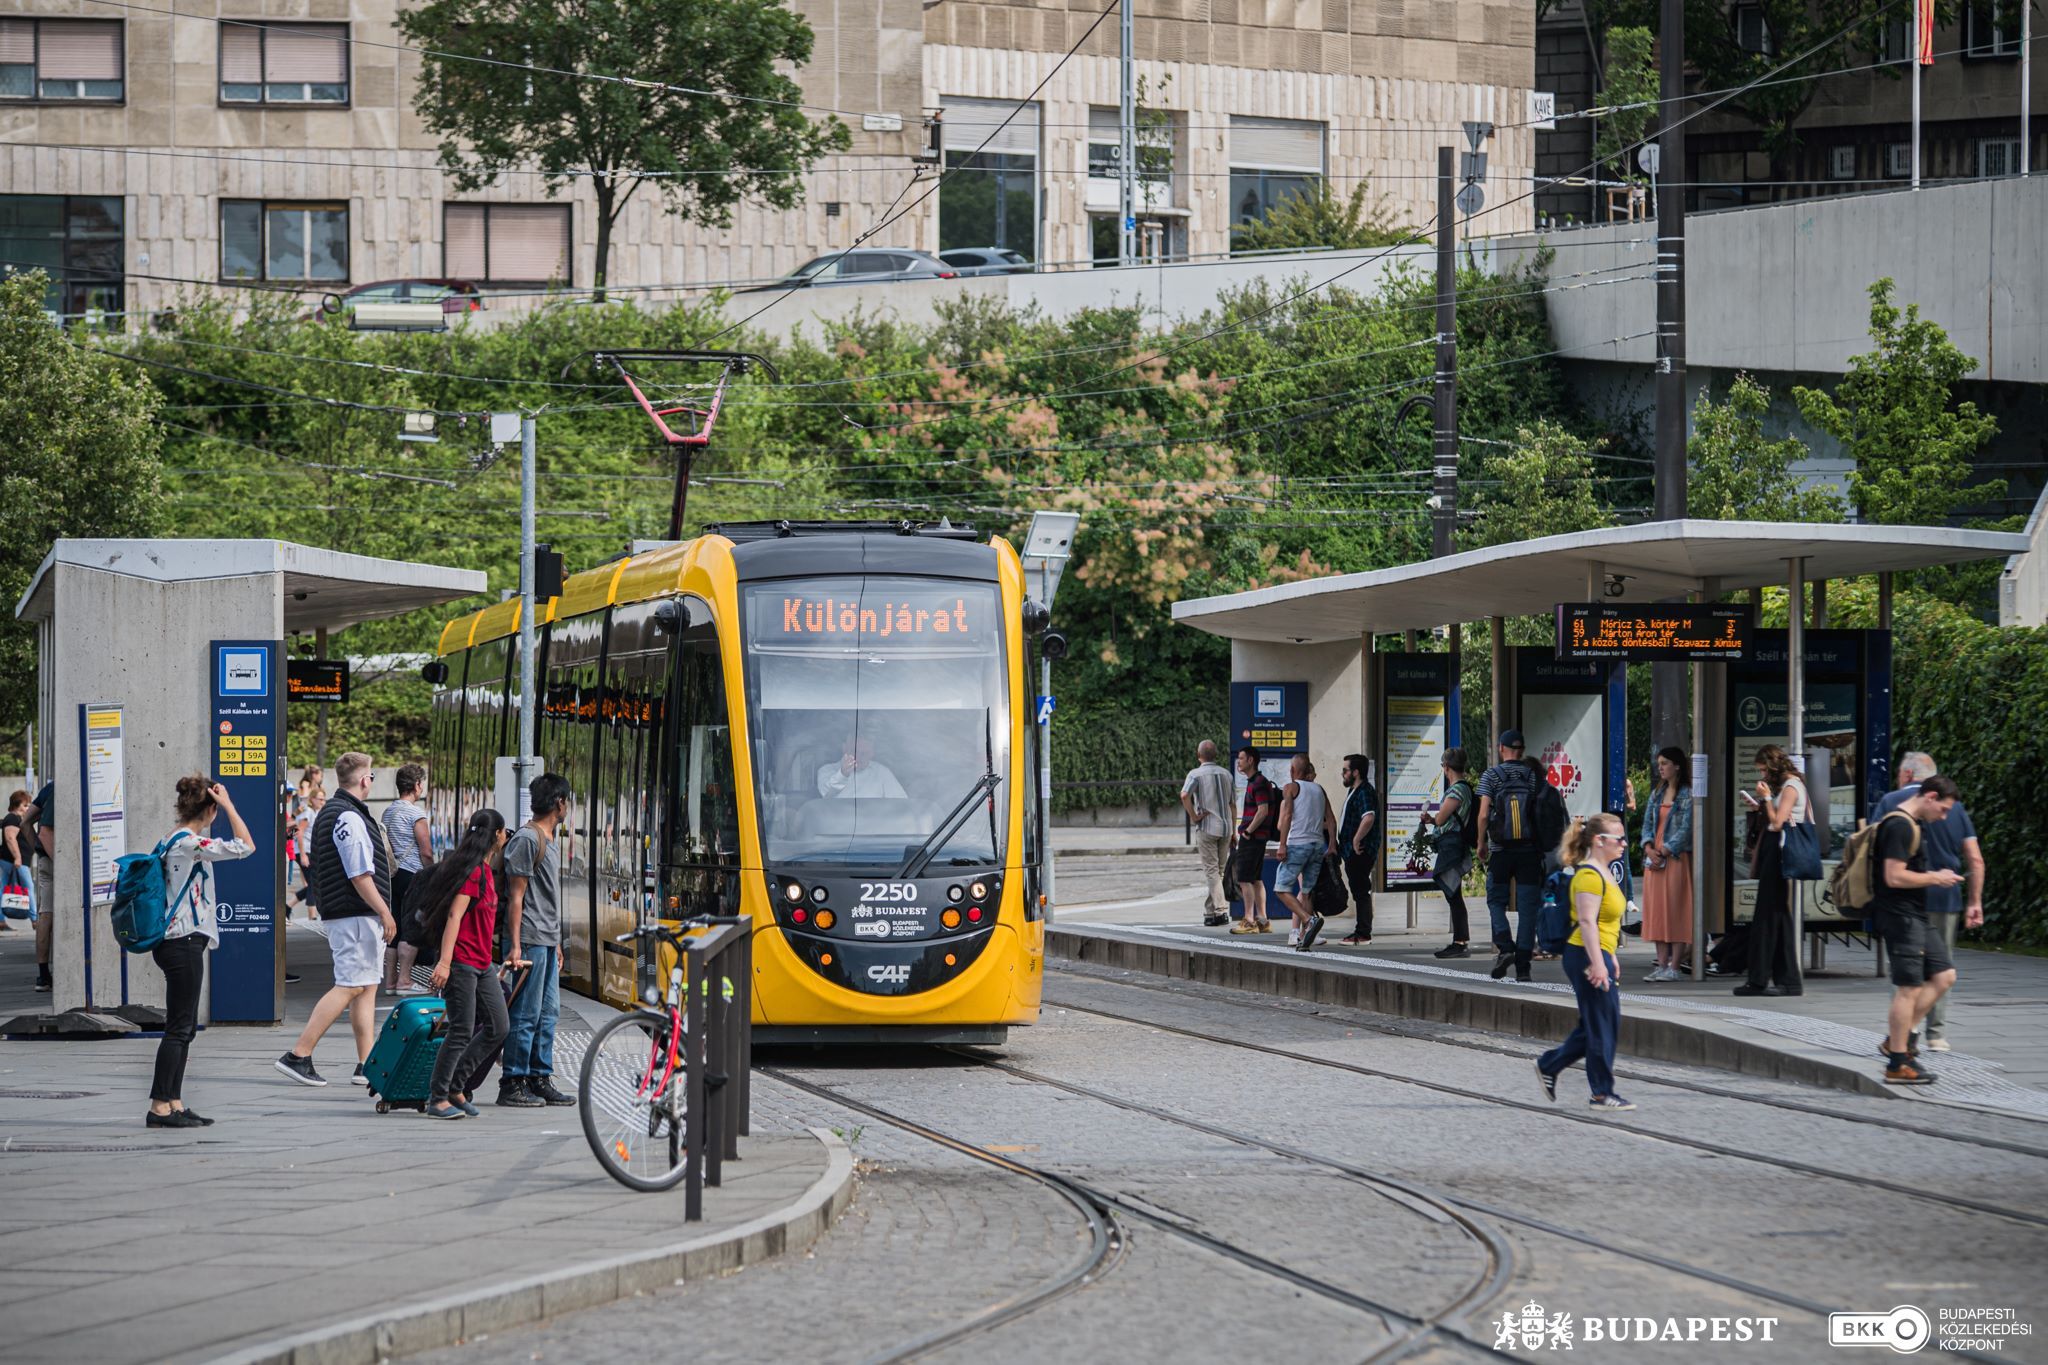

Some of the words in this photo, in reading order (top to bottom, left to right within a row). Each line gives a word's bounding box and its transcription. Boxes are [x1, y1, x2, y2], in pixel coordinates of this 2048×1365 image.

[784, 599, 968, 637] Különjárat
[1573, 619, 1584, 629] 61
[1600, 618, 1632, 629] Móricz
[1651, 618, 1680, 629] körtér
[1683, 619, 1692, 629] M
[1573, 628, 1585, 638] 59
[1600, 628, 1633, 638] Márton
[1660, 628, 1675, 638] tér
[1592, 637, 1619, 647] közös
[1673, 637, 1711, 648] Szavazz
[1823, 651, 1837, 662] tér
[226, 752, 236, 760] 59
[248, 752, 264, 760] 59A
[860, 883, 917, 901] 2250
[875, 907, 927, 915] BUDAPEST
[867, 965, 911, 983] CAF
